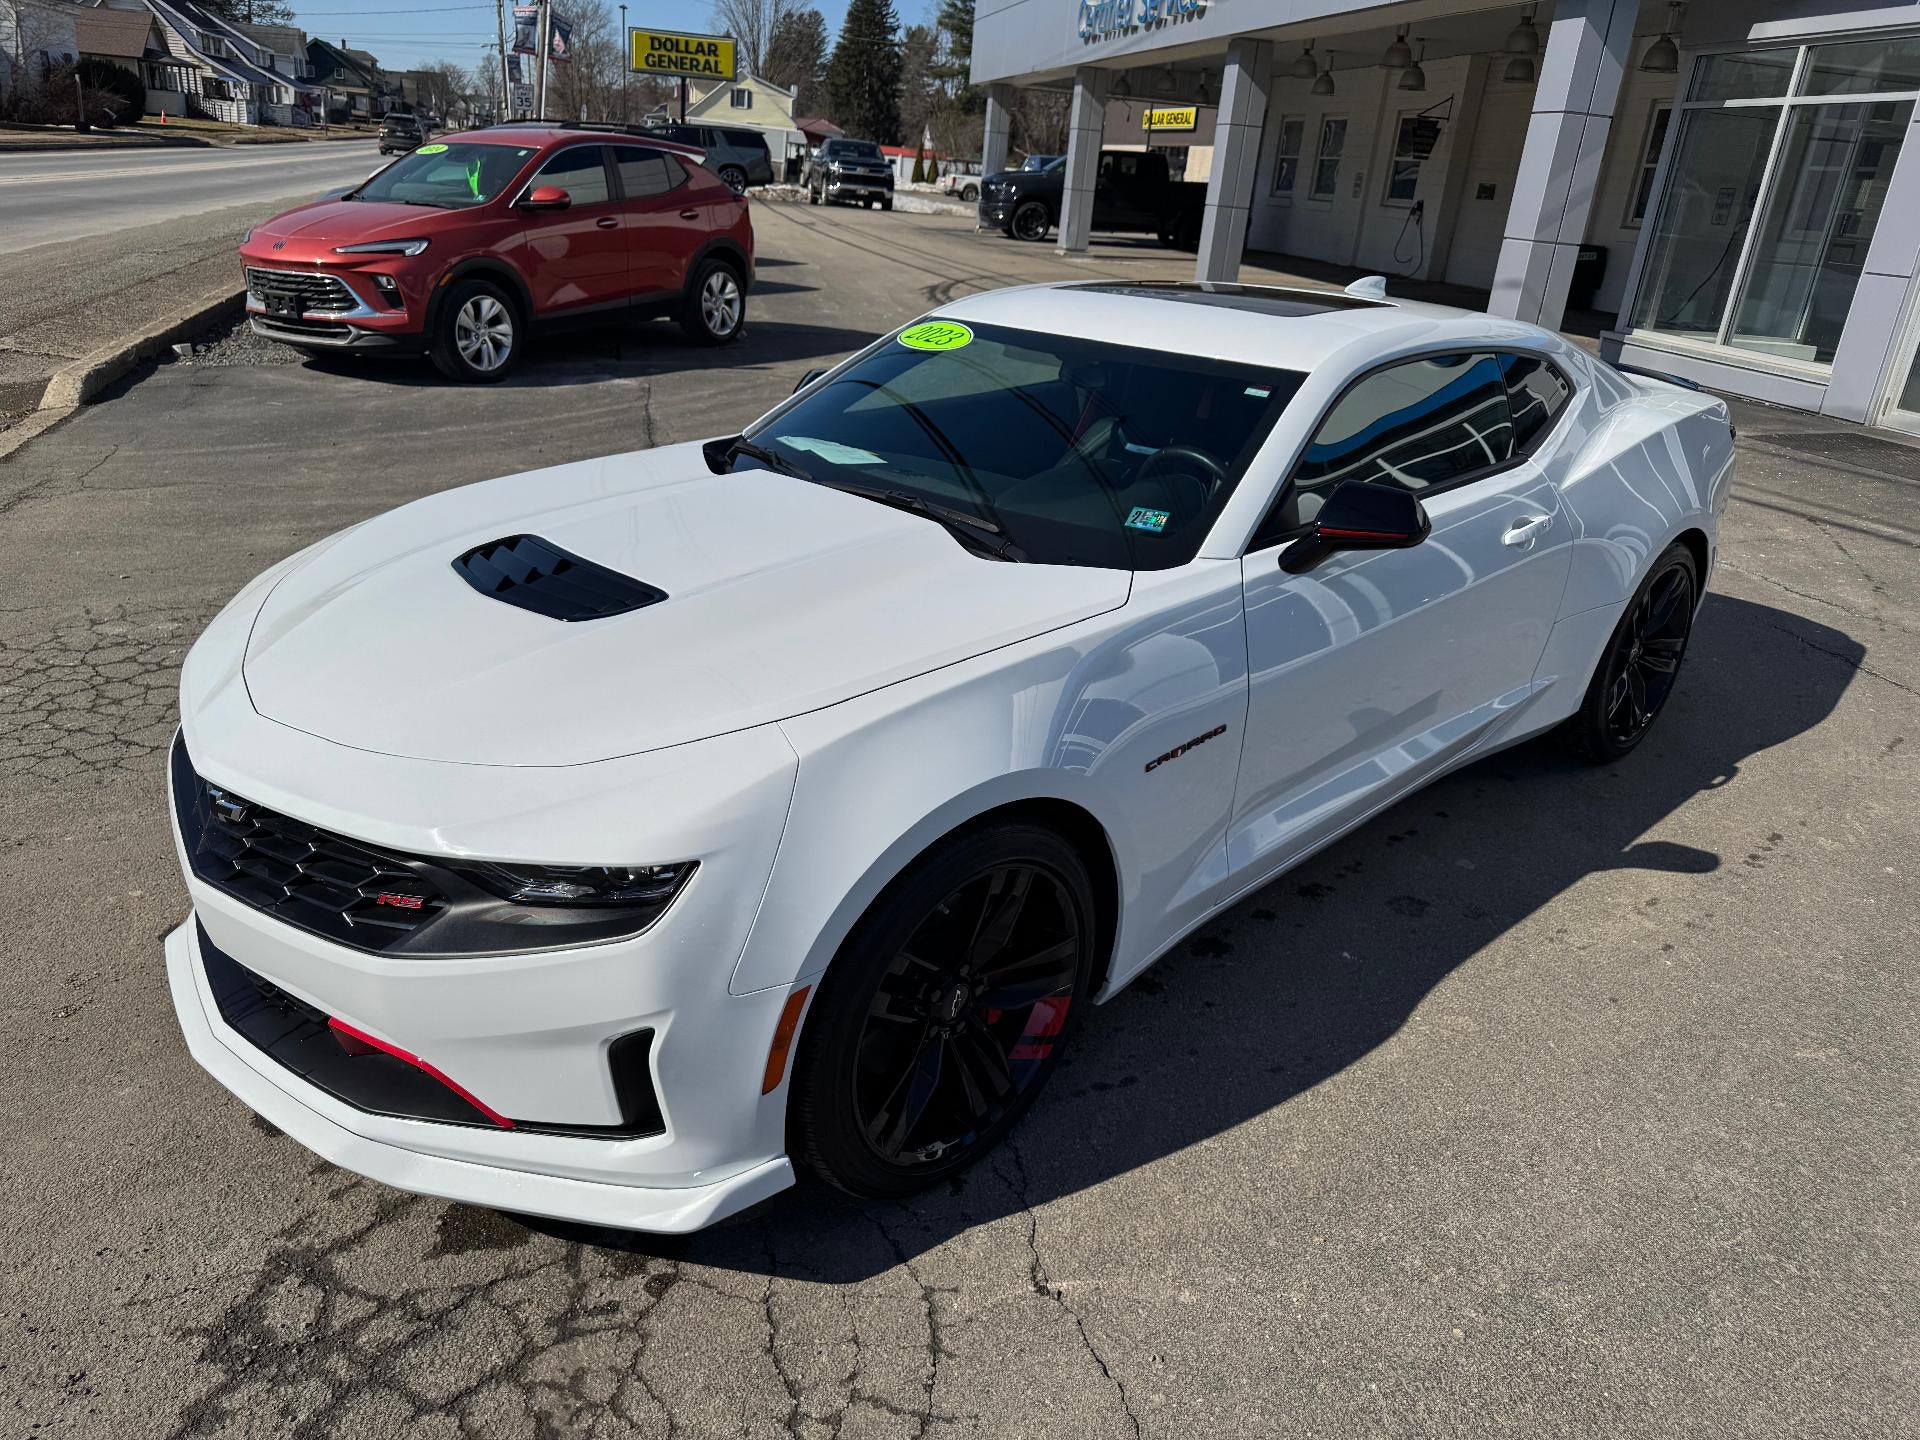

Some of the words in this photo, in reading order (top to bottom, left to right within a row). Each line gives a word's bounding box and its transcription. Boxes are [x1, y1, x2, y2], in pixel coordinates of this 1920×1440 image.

[649, 36, 719, 57] DOLLAR
[644, 53, 723, 74] GENERAL
[516, 97, 532, 108] 35
[1166, 111, 1192, 125] GENERAL
[904, 326, 965, 346] 2023
[1145, 724, 1227, 773] CAMARO
[377, 893, 423, 909] RS
